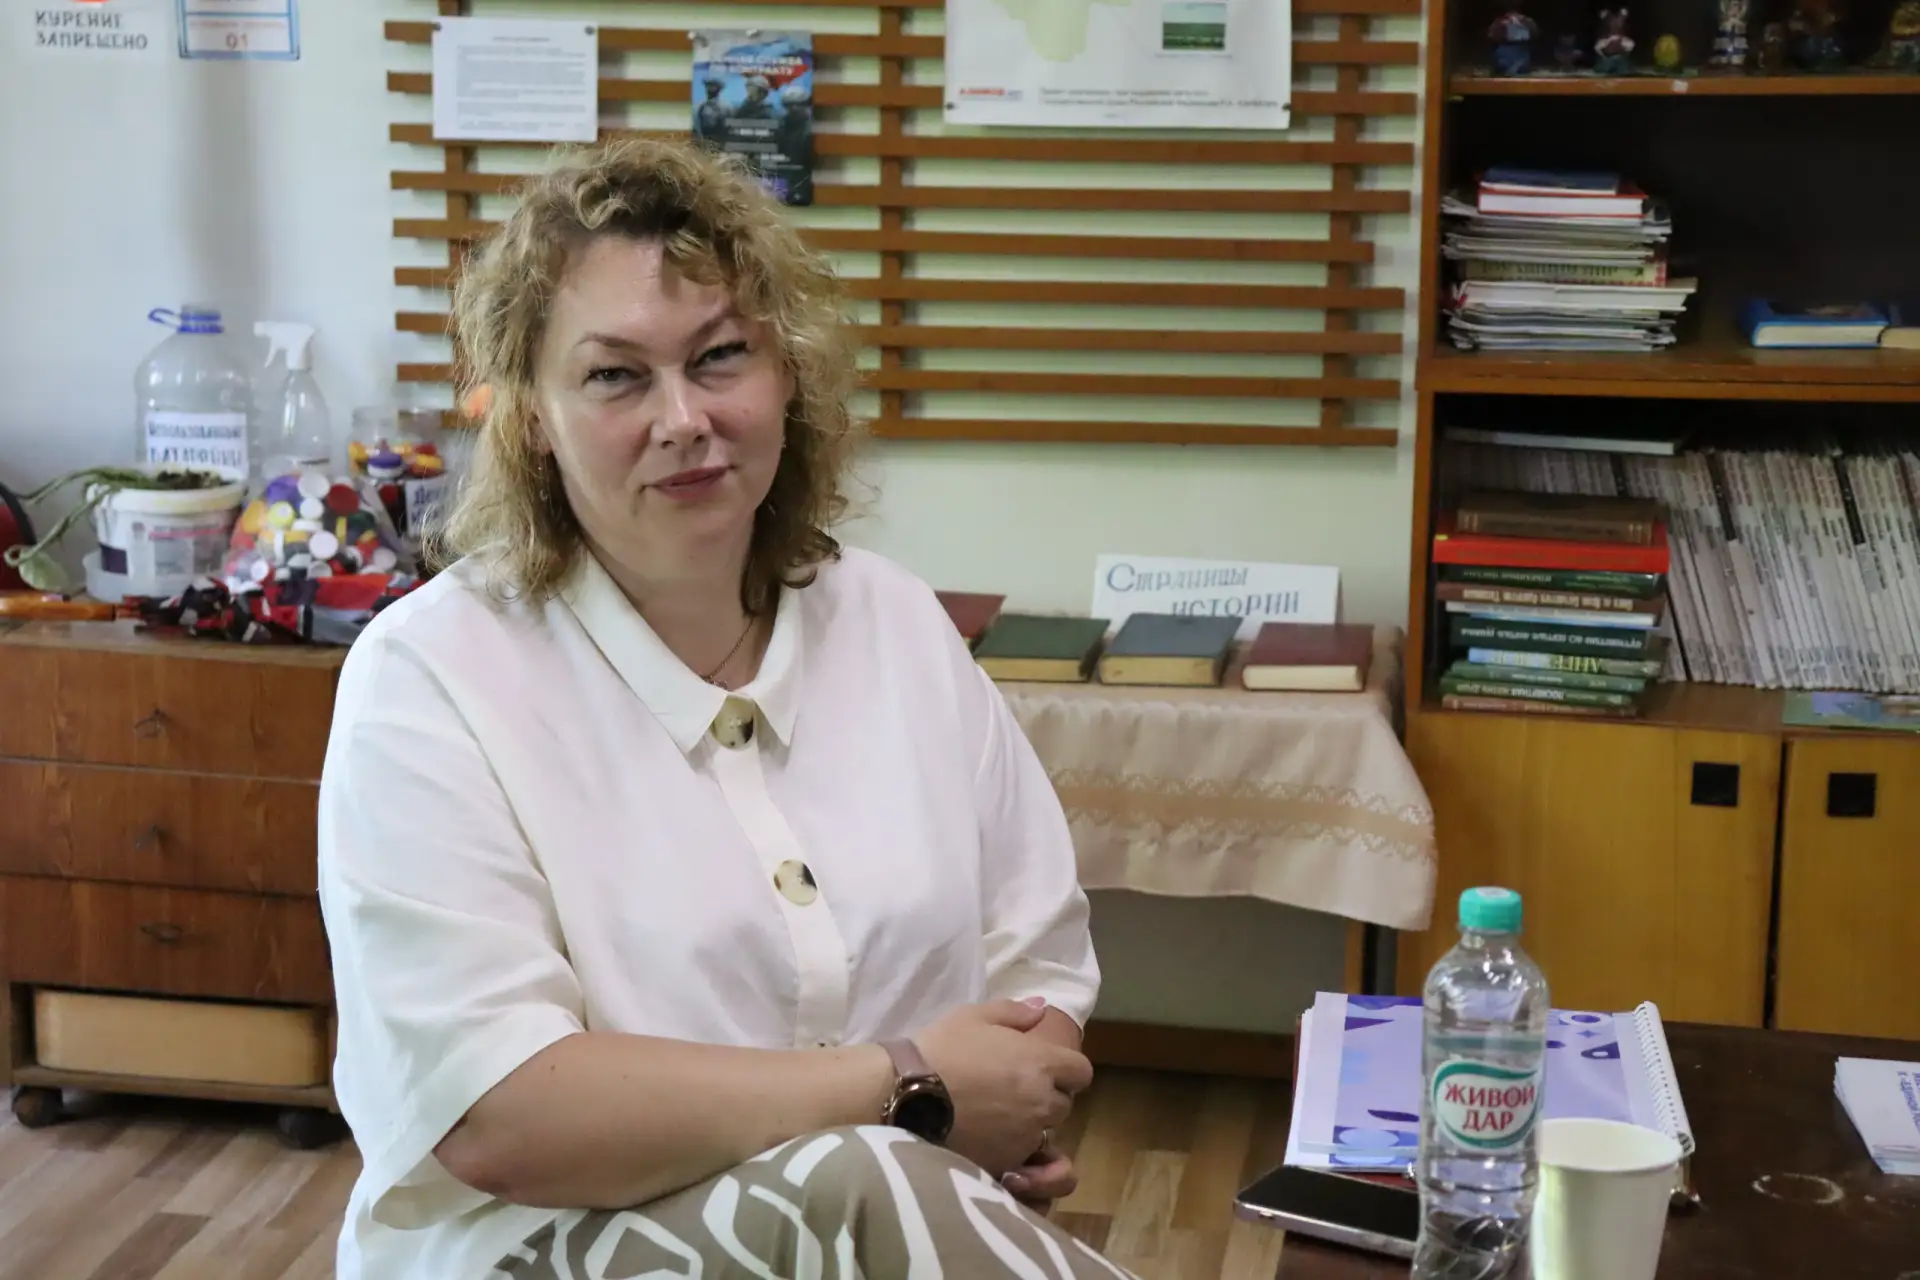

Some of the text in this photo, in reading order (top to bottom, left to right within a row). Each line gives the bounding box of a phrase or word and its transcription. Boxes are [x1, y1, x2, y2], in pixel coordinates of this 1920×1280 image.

[35, 10, 123, 28] КУРЕНИЕ
[36, 32, 148, 49] ЗАПРЕЩЕНО
[225, 32, 248, 49] 01
[1444, 1081, 1535, 1108] ЖИВОЙ
[1462, 1109, 1514, 1132] ДАР
